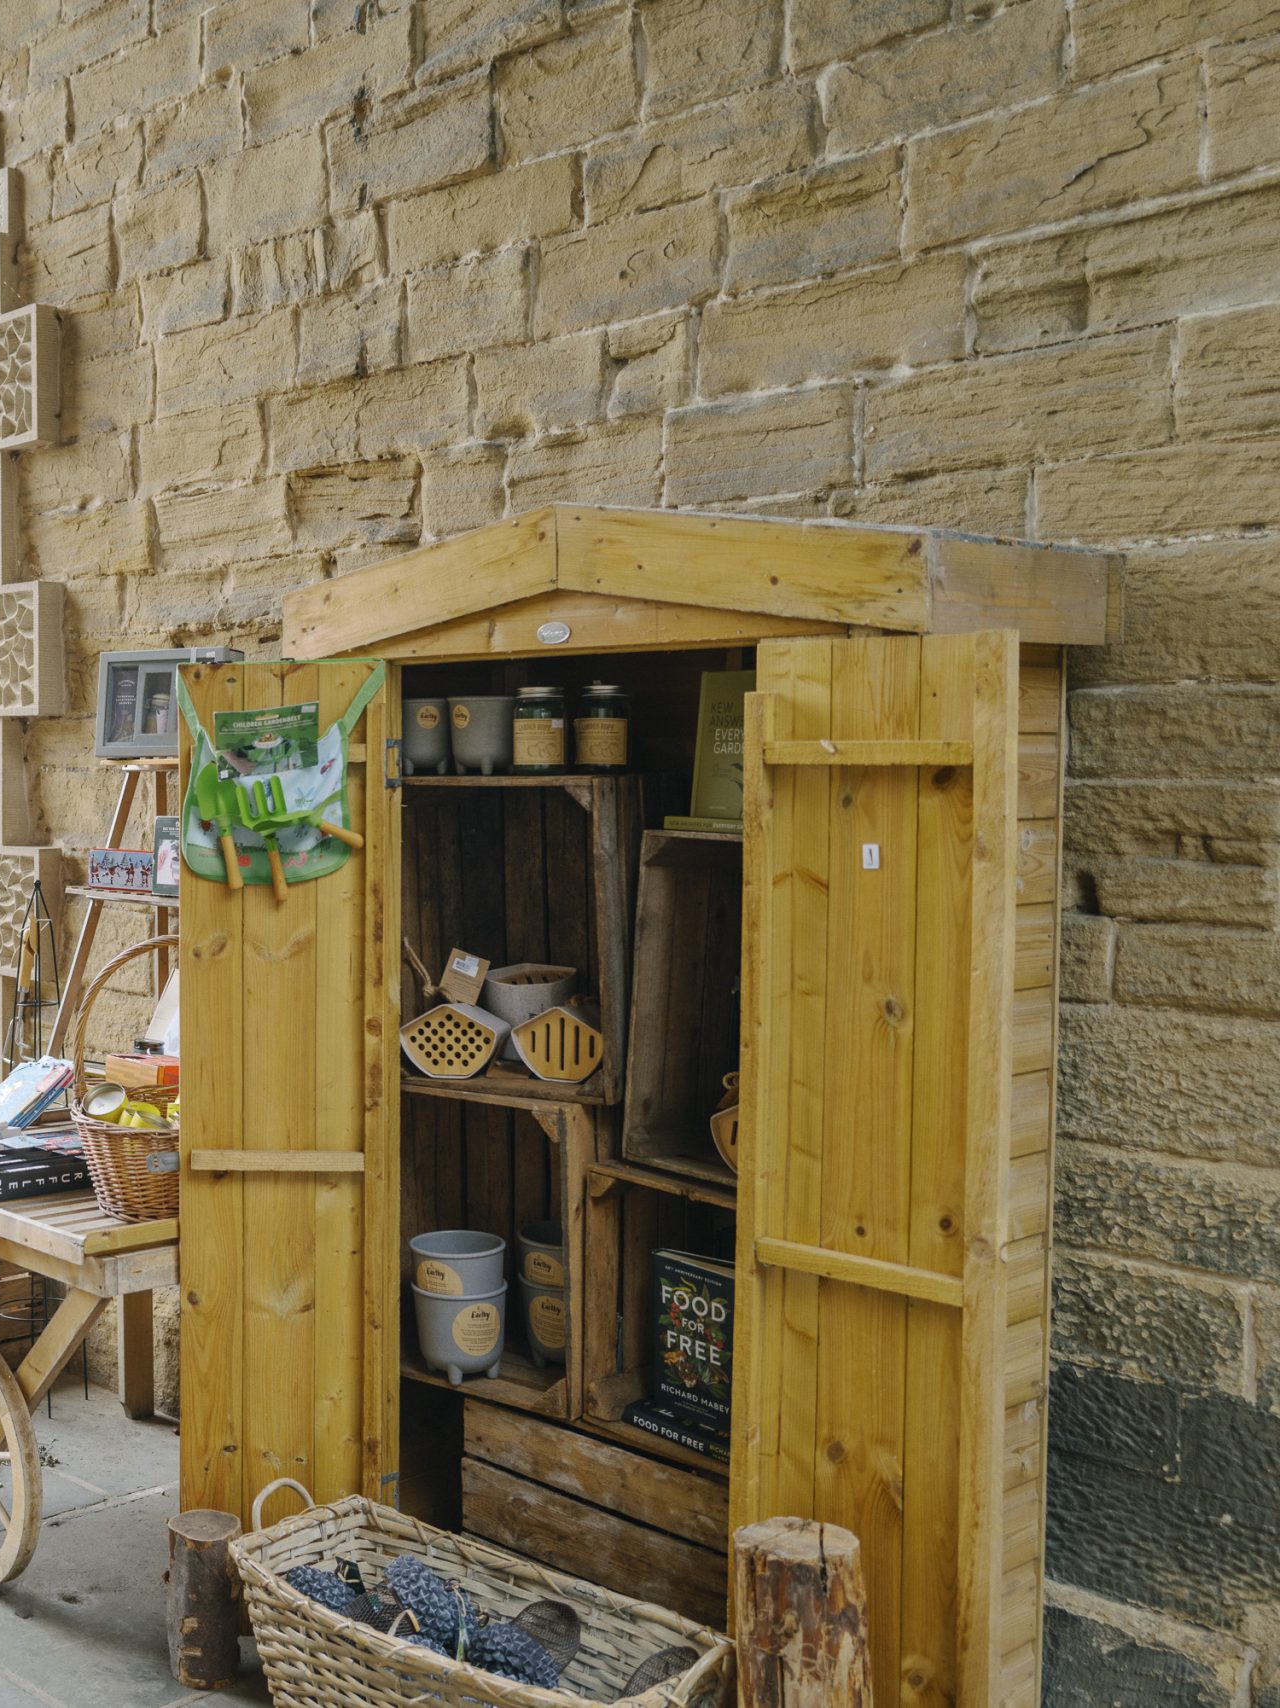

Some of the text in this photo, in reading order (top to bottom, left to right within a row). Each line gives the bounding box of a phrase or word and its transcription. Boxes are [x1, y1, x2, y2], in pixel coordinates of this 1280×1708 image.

[232, 719, 263, 729] CHILDREN
[8, 1172, 89, 1190] RUFFLE
[661, 1284, 725, 1322] FOOD
[681, 1317, 704, 1335] FOR
[666, 1329, 721, 1367] FREE
[660, 1383, 698, 1403] RICHARD
[700, 1398, 729, 1415] MABEY
[633, 1415, 705, 1452] FOOD FOR FREE
